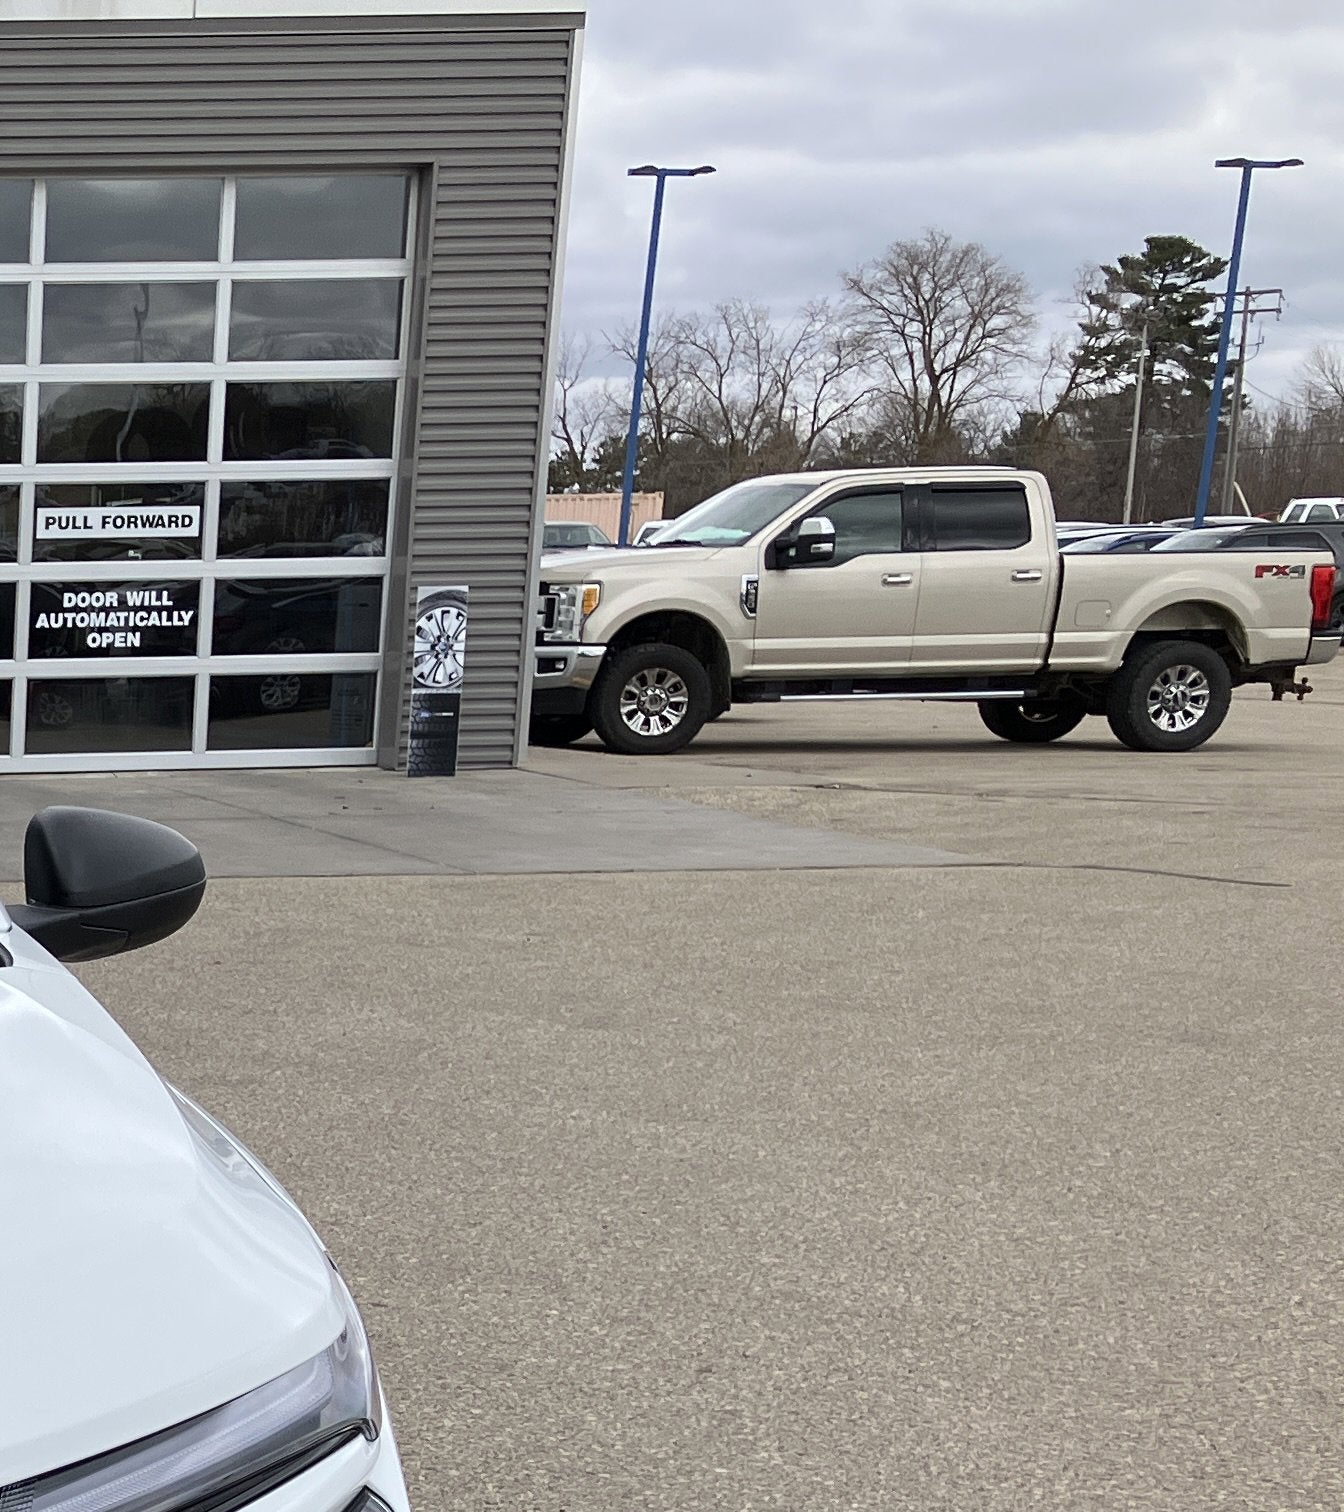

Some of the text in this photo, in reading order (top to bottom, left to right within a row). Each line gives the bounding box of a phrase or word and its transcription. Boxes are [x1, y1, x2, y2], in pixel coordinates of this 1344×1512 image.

[44, 514, 194, 530] PULL FORWARD
[1254, 564, 1306, 579] FX4
[62, 590, 174, 608] DOOR WILL
[35, 610, 195, 629] AUTOMATICALLY
[87, 631, 141, 648] OPEN
